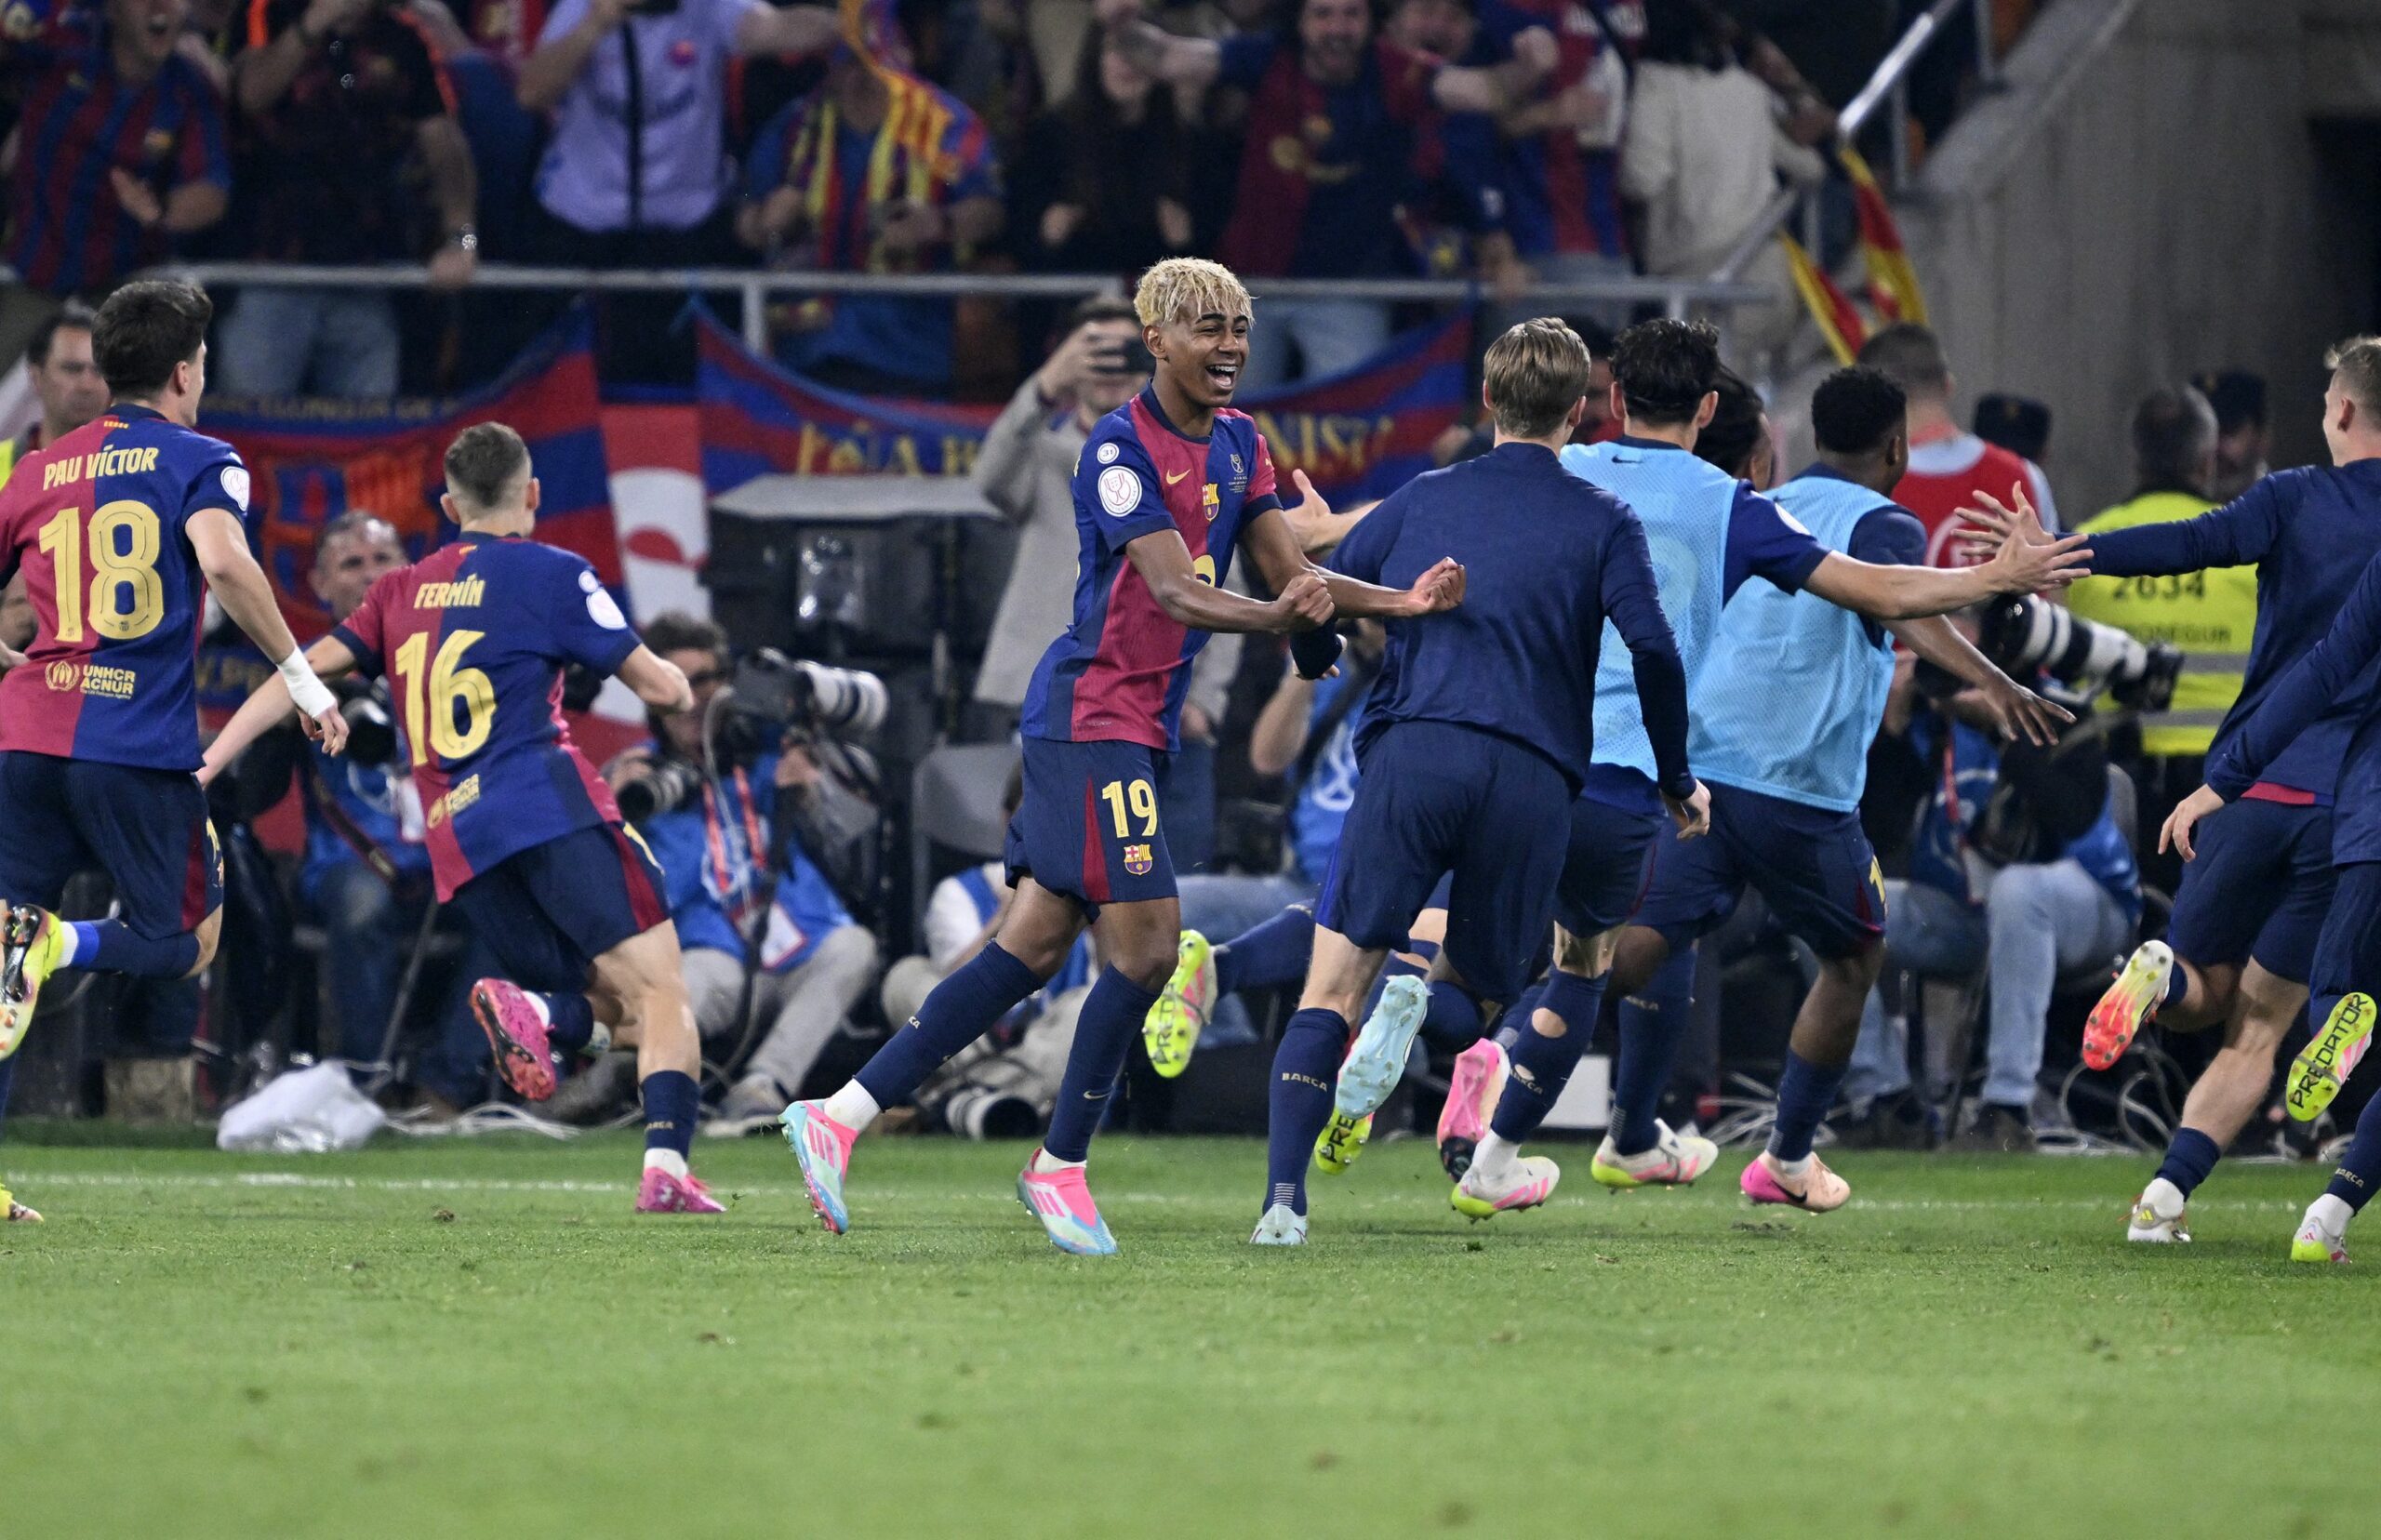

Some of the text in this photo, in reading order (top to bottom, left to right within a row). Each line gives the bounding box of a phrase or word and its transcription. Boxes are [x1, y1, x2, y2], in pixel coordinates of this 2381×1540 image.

[43, 444, 159, 491] PAU VÍCTOR
[38, 498, 165, 643] 18
[414, 574, 486, 609] FERMÍN
[80, 676, 134, 695] ACNUR
[82, 664, 136, 683] UNHCR
[395, 630, 498, 767] 16
[1101, 778, 1158, 839] 19
[2289, 993, 2369, 1109] PREDATOR
[1318, 1114, 1357, 1164] PRE
